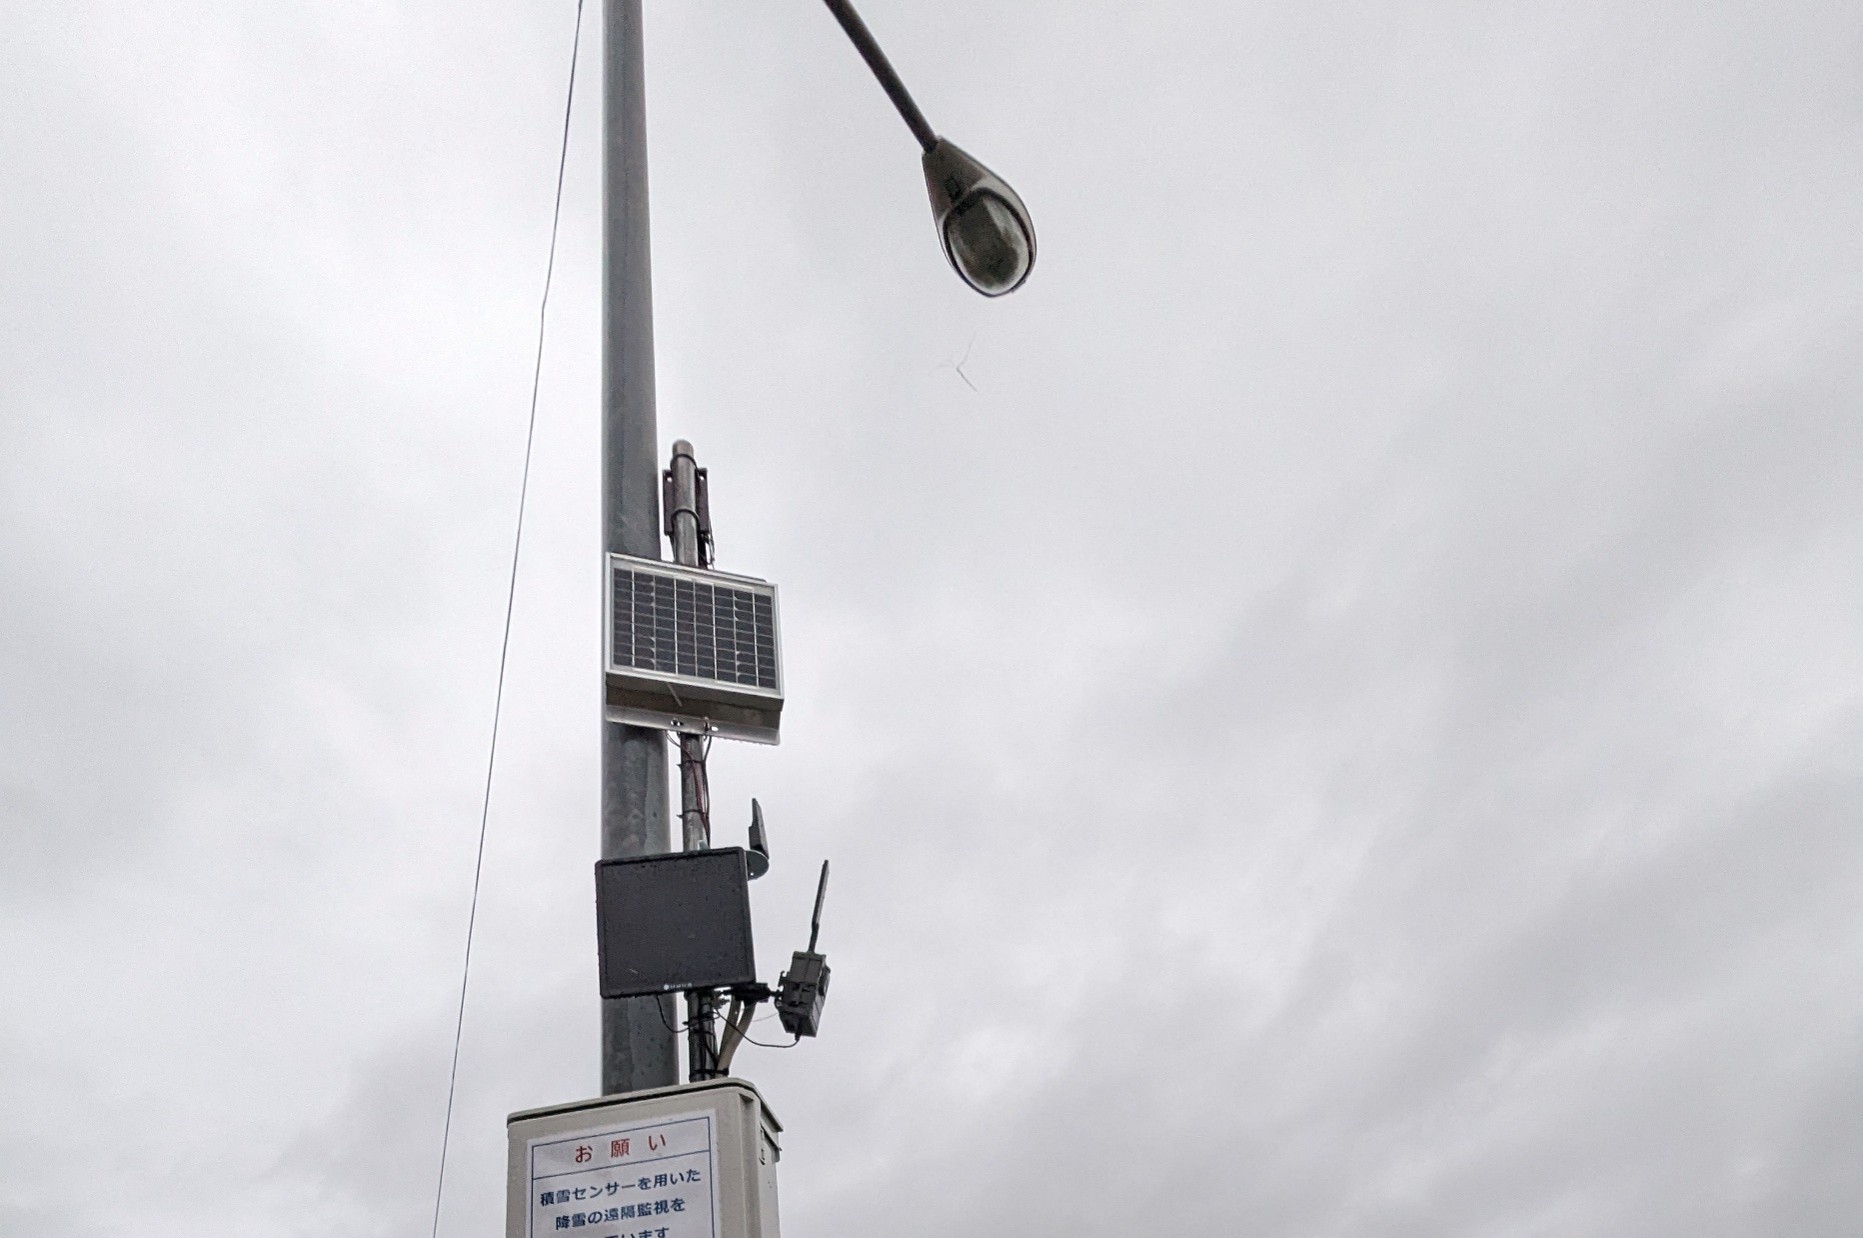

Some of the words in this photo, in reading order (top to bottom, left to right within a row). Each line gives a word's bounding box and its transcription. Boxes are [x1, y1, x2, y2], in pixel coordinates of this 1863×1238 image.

[575, 1134, 666, 1163] お願い
[540, 1168, 702, 1207] 積雪センサーを用いた
[556, 1198, 686, 1231] 降雪の遠隔監視を
